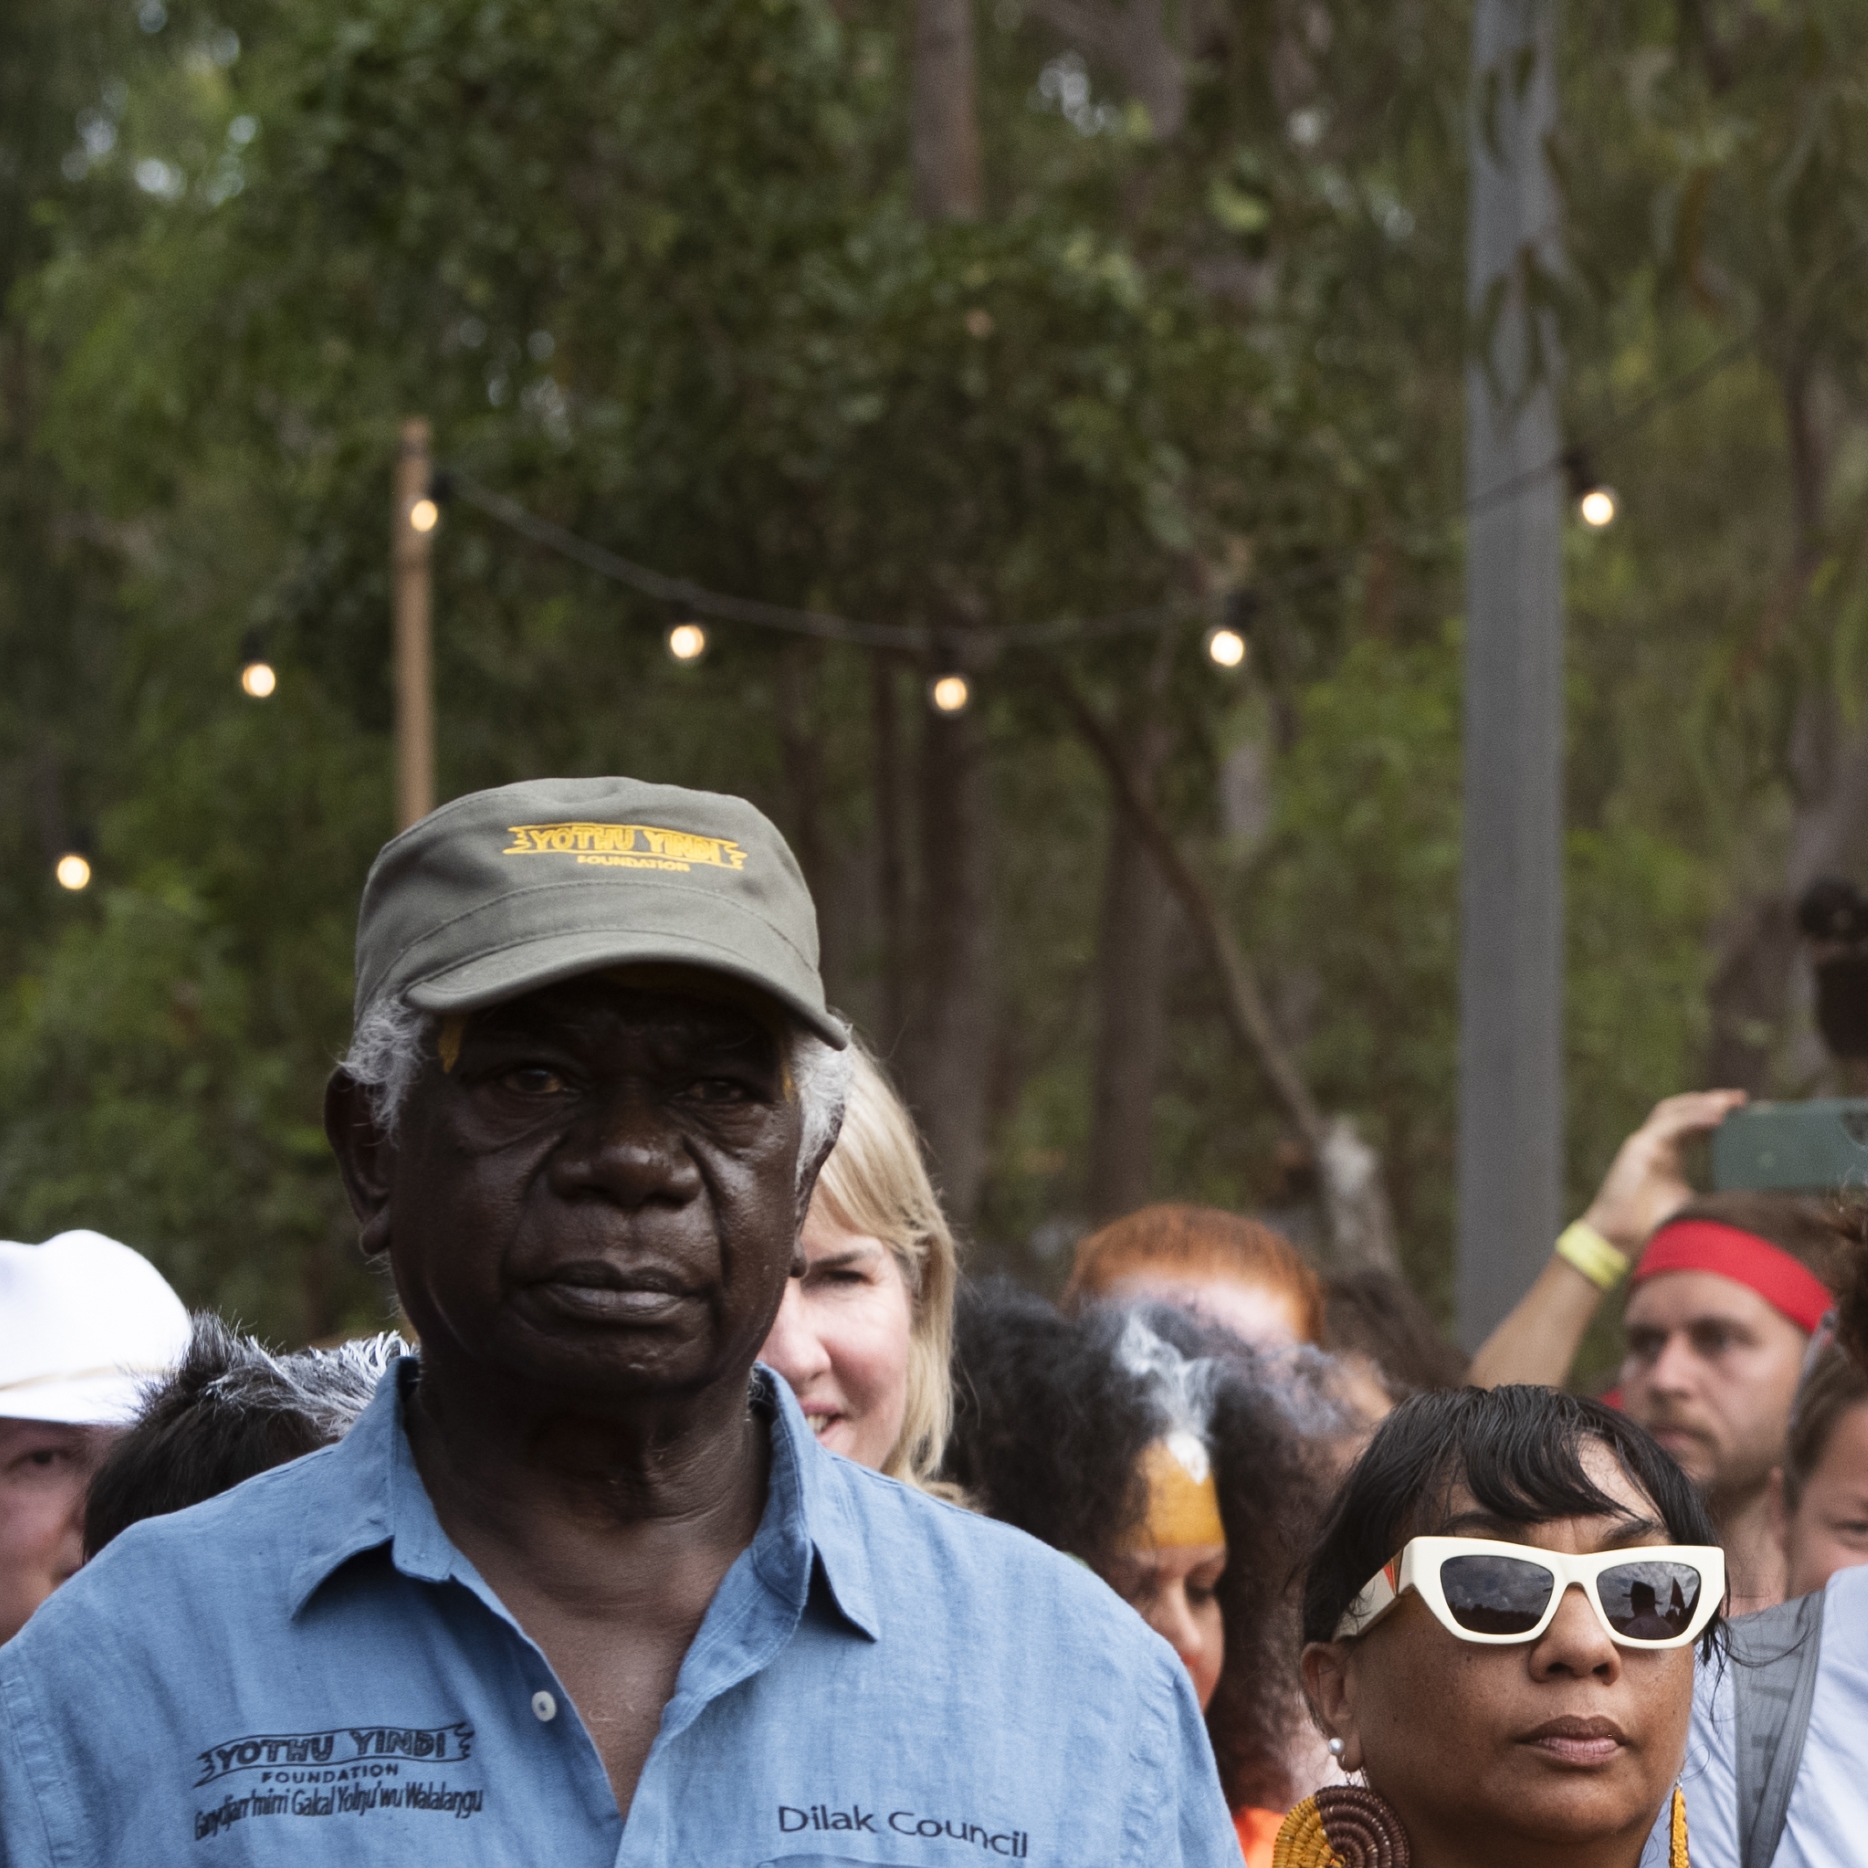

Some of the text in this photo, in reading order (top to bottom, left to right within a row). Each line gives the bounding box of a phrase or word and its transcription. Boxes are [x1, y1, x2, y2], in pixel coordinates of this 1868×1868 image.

[529, 826, 722, 863] YOTHU YINDI
[577, 855, 691, 871] FOUNDATION
[216, 1730, 446, 1770] YOTHU YINDI
[261, 1763, 399, 1784] FOUNDATION
[778, 1804, 1028, 1858] Dilak Council
